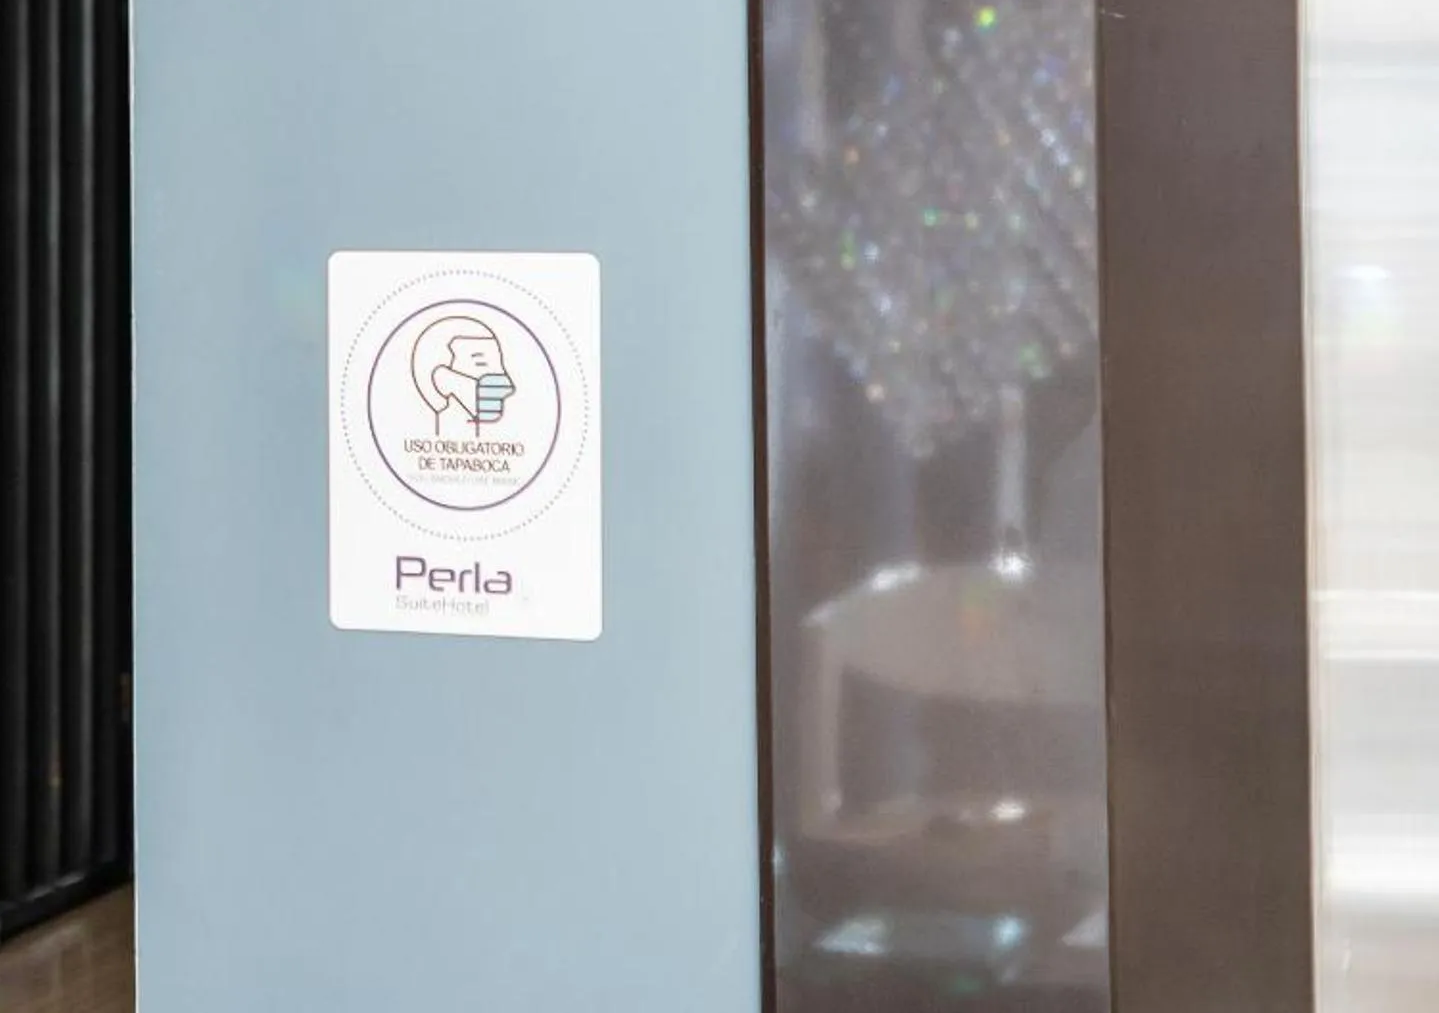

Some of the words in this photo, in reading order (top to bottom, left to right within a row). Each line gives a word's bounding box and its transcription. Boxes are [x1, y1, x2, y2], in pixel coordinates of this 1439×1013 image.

[404, 439, 432, 453] USO
[435, 440, 525, 457] OBLIGATORIO
[419, 456, 436, 470] DE
[440, 457, 510, 473] TAPABOCA
[395, 555, 512, 595] Perla
